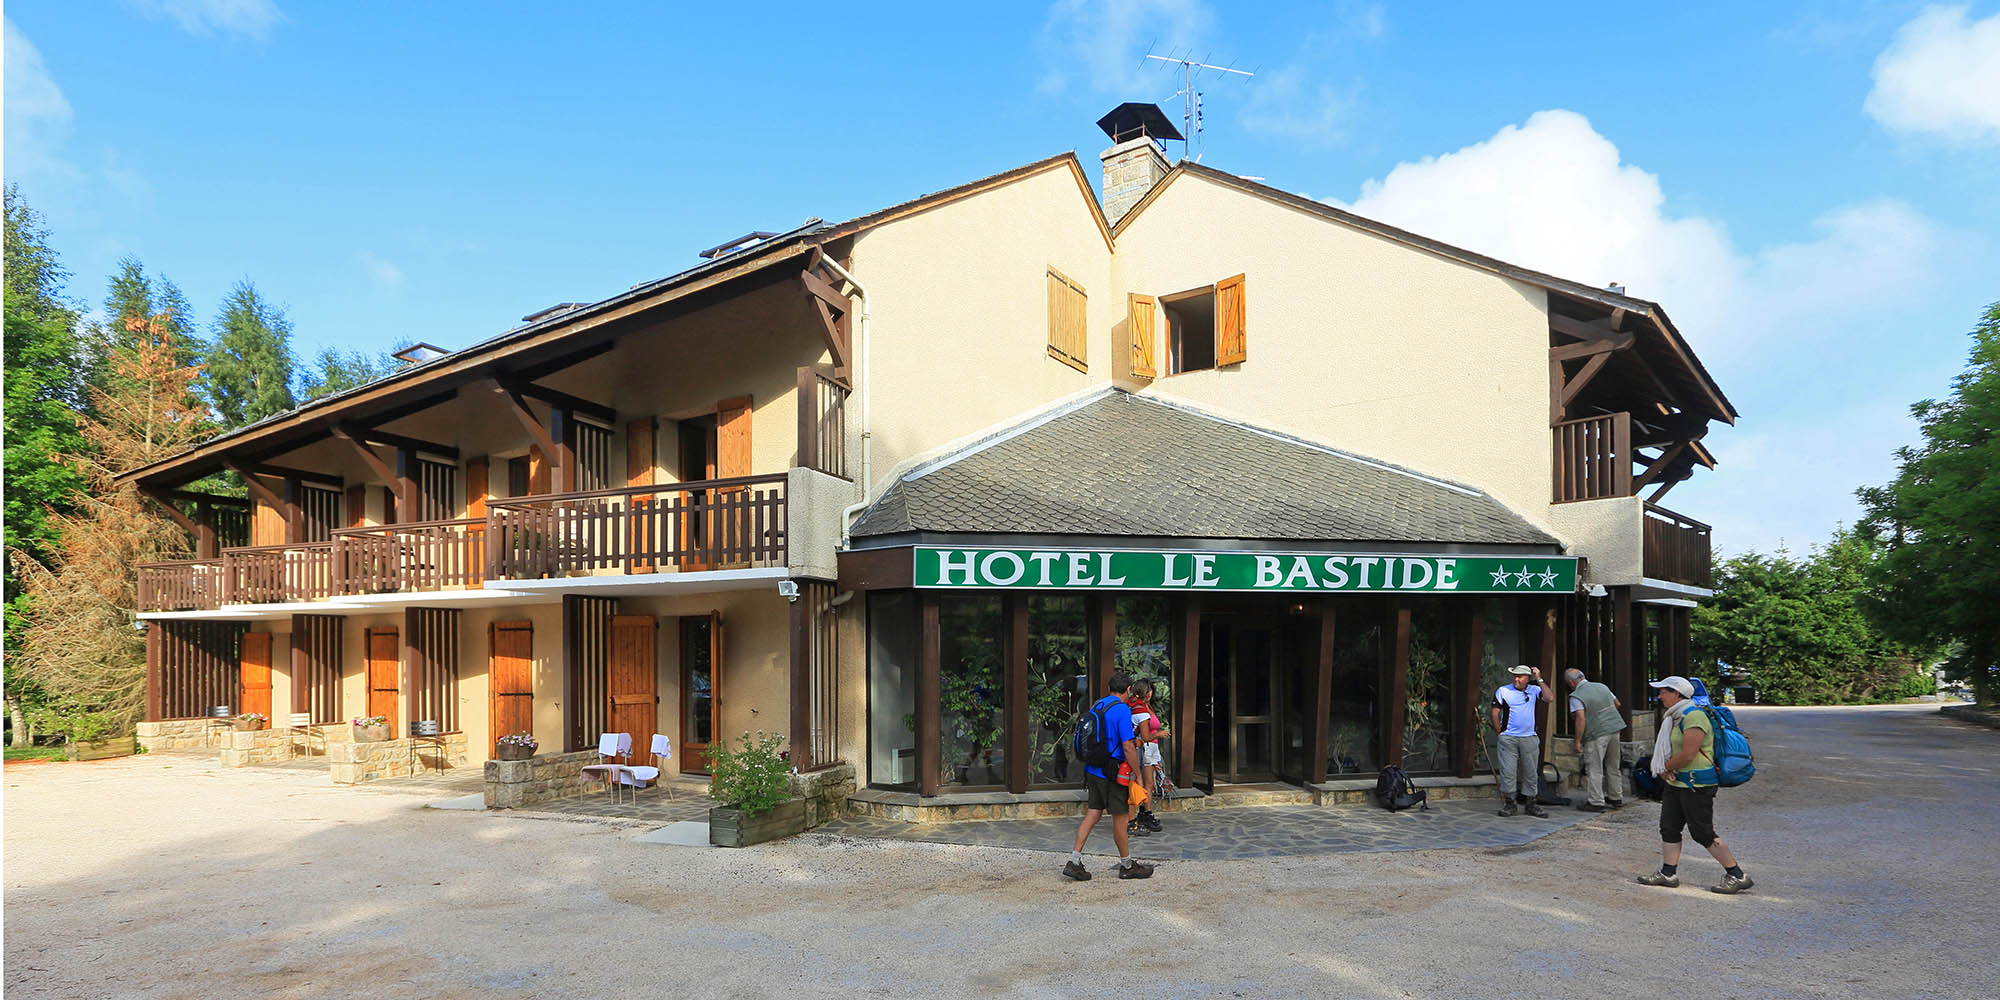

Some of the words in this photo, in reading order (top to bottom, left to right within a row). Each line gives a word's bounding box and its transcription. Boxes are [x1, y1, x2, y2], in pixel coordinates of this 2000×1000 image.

[936, 551, 1127, 586] HOTEL
[1161, 554, 1221, 586] LE
[1253, 555, 1459, 590] BASTIDE
